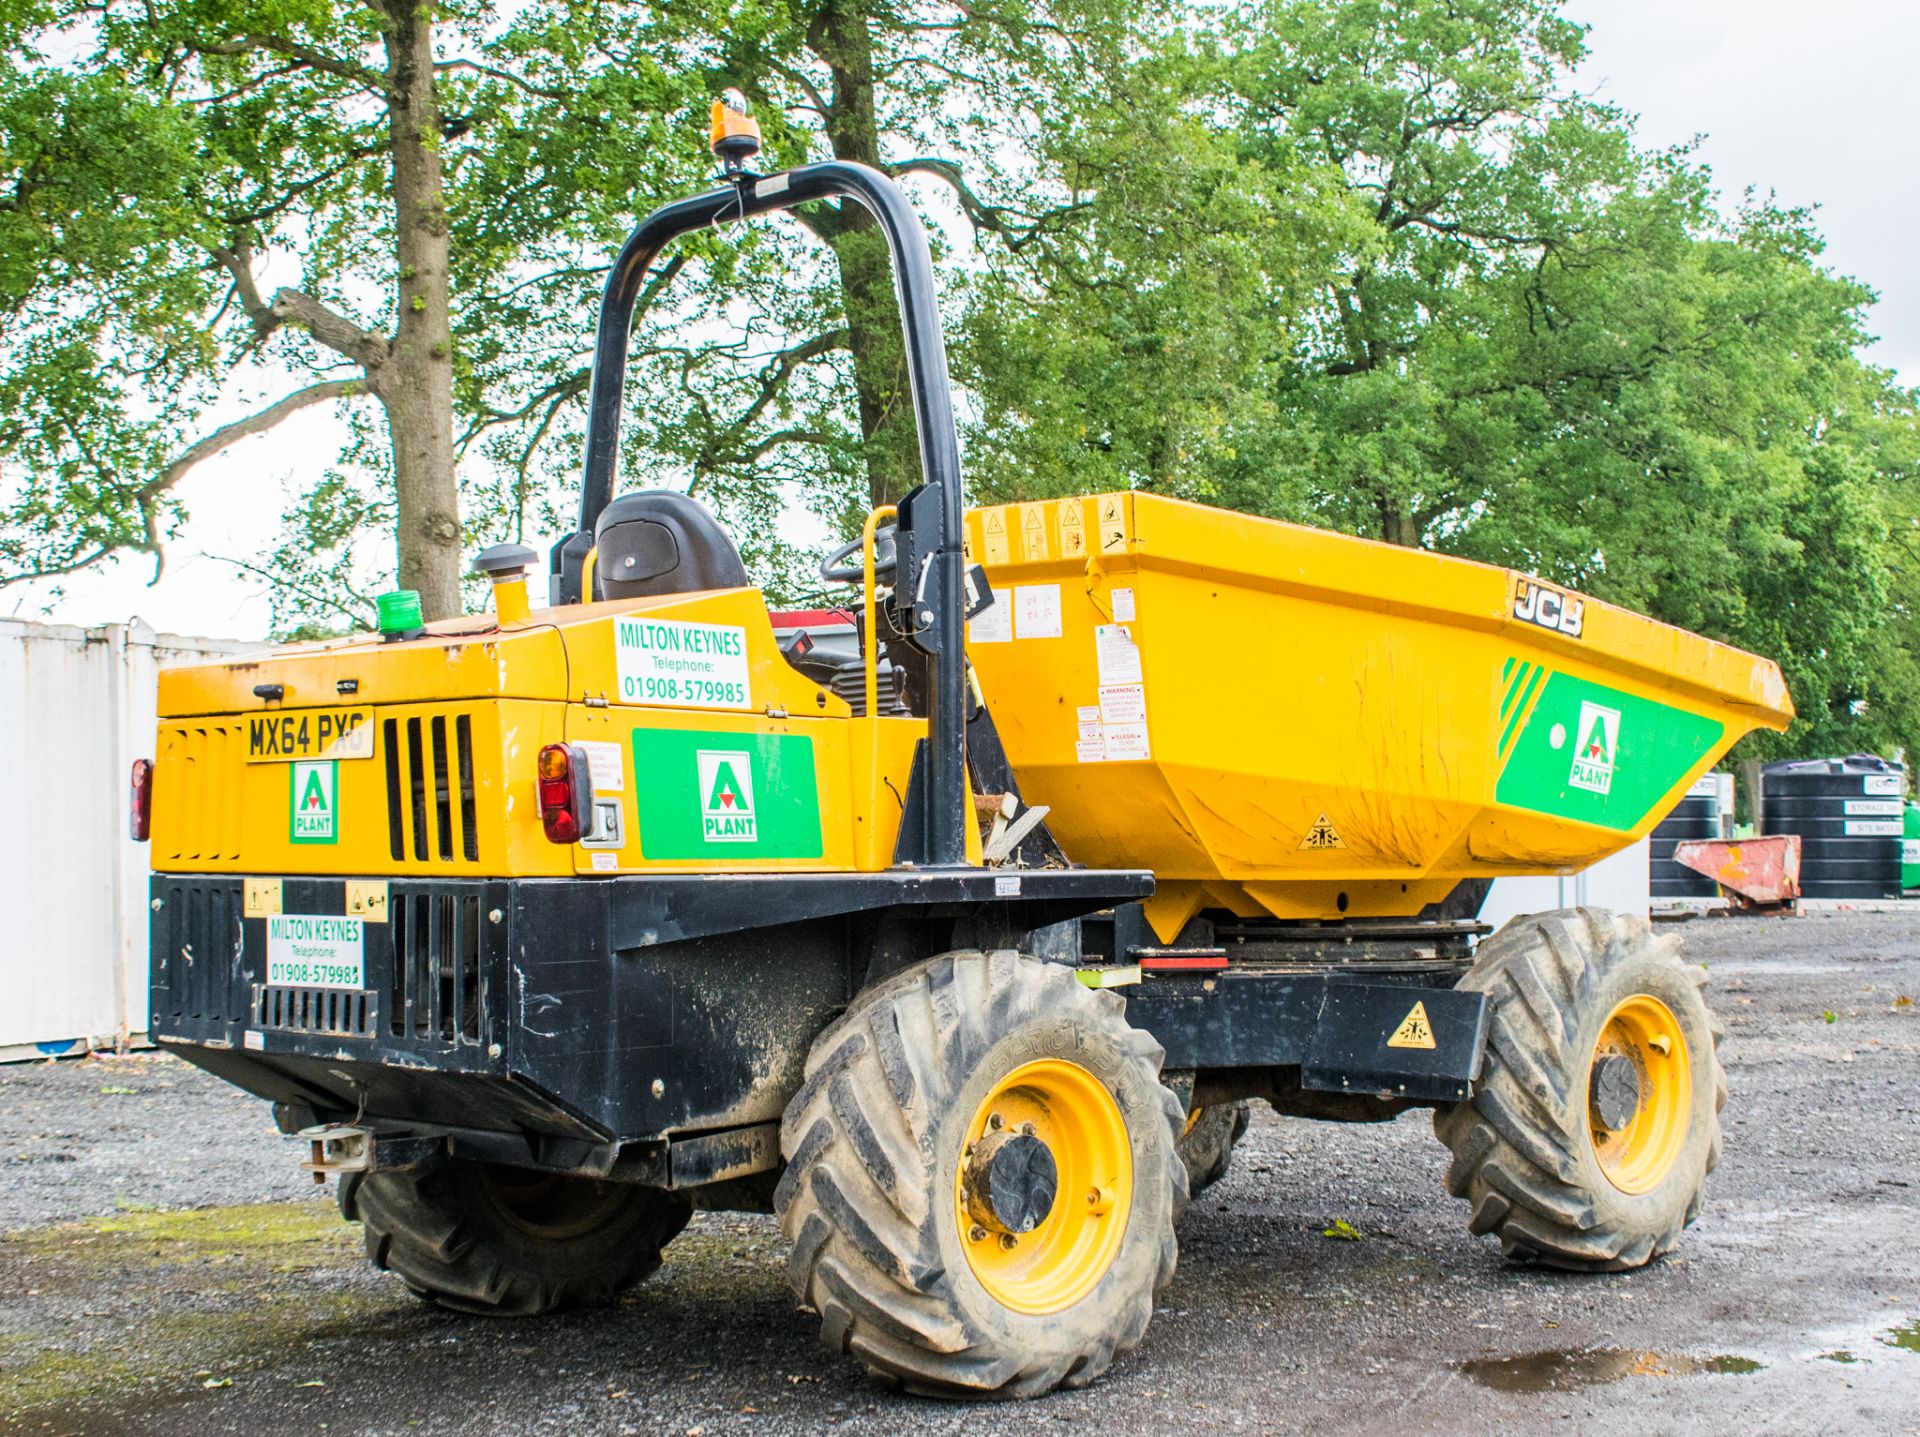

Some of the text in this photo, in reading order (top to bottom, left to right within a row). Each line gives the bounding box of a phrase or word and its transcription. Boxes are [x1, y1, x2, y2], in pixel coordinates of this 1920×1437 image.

[1514, 583, 1584, 637] JCB
[620, 622, 741, 656] MILTON KEYNES
[652, 656, 715, 673] Telephone:
[624, 676, 745, 703] 01908-579985
[249, 716, 311, 756] MX64
[1579, 715, 1610, 765] A
[708, 761, 749, 810] A
[1571, 764, 1611, 788] PLANT
[299, 769, 328, 811] A
[296, 817, 331, 832] PLANT
[705, 818, 754, 836] PLANT
[271, 918, 360, 942] MILTON KEYNES
[291, 944, 338, 960] Telephone:
